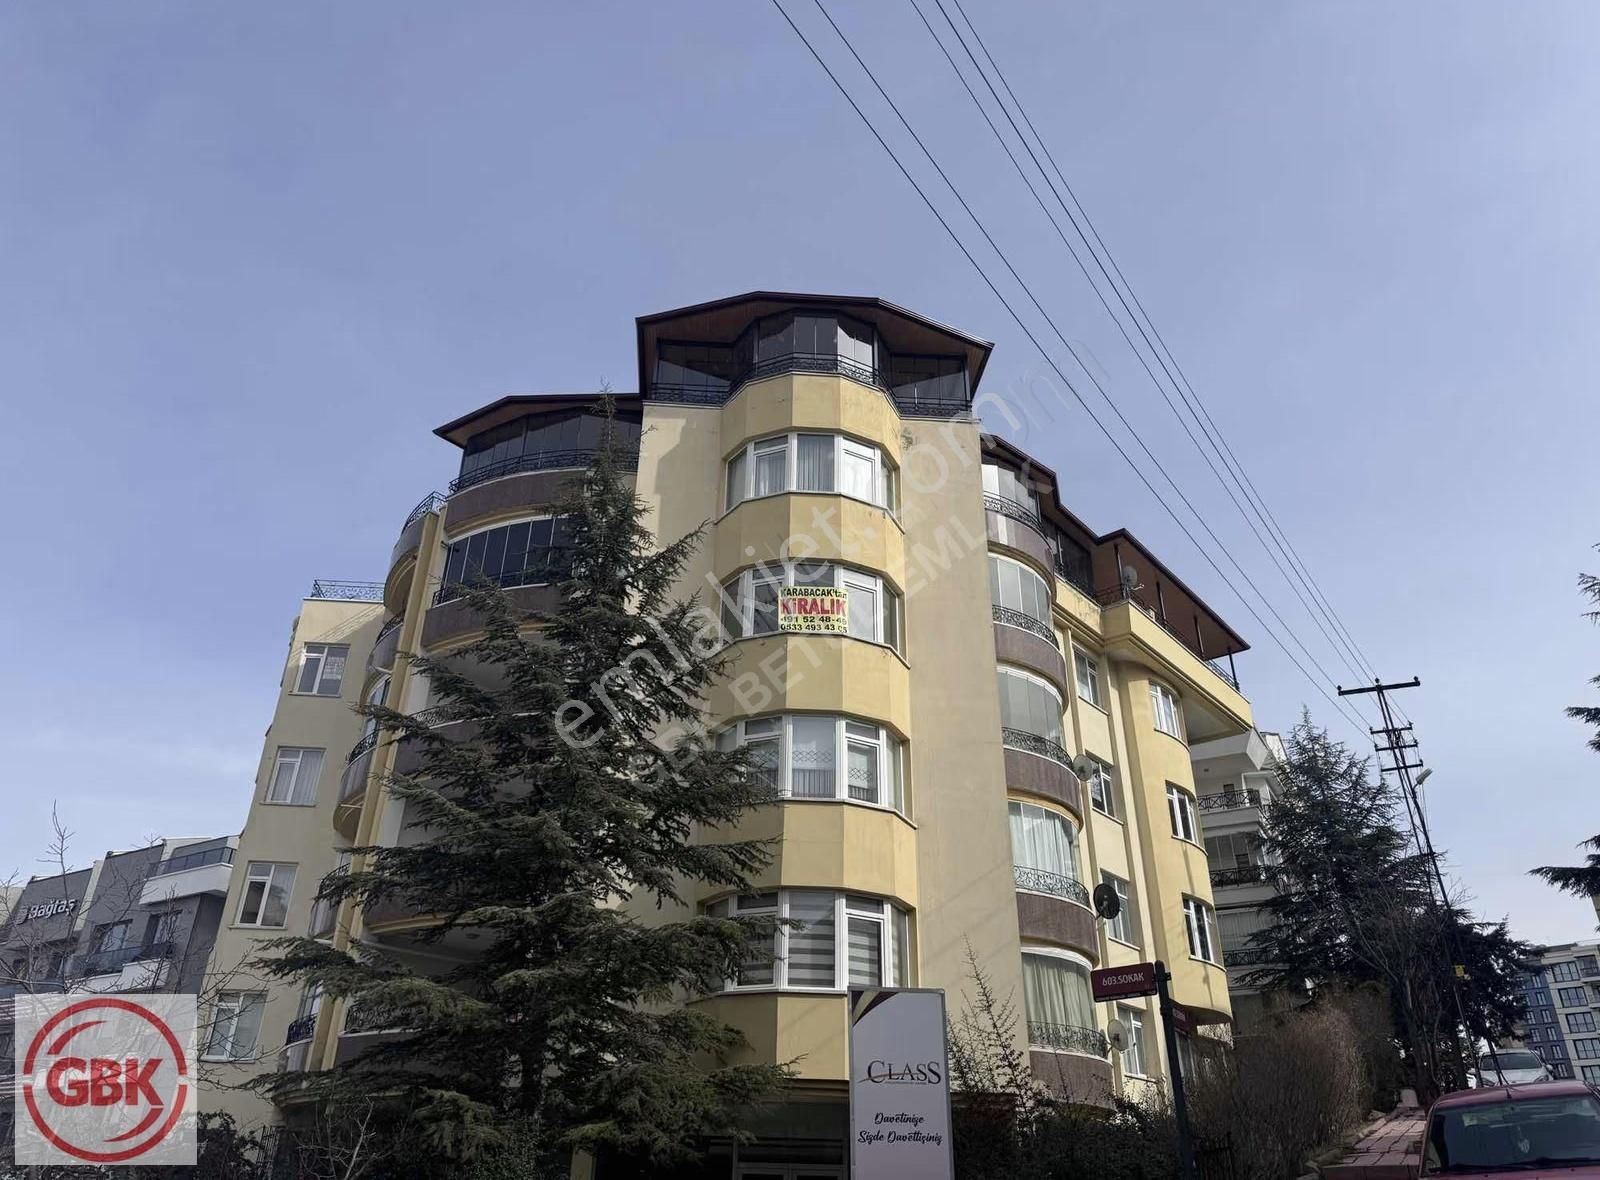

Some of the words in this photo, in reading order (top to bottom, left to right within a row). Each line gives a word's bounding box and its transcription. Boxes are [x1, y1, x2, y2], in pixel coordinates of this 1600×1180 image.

[867, 1060, 942, 1085] CLASS
[874, 1112, 924, 1127] Davetinize
[858, 1130, 884, 1144] Sizde
